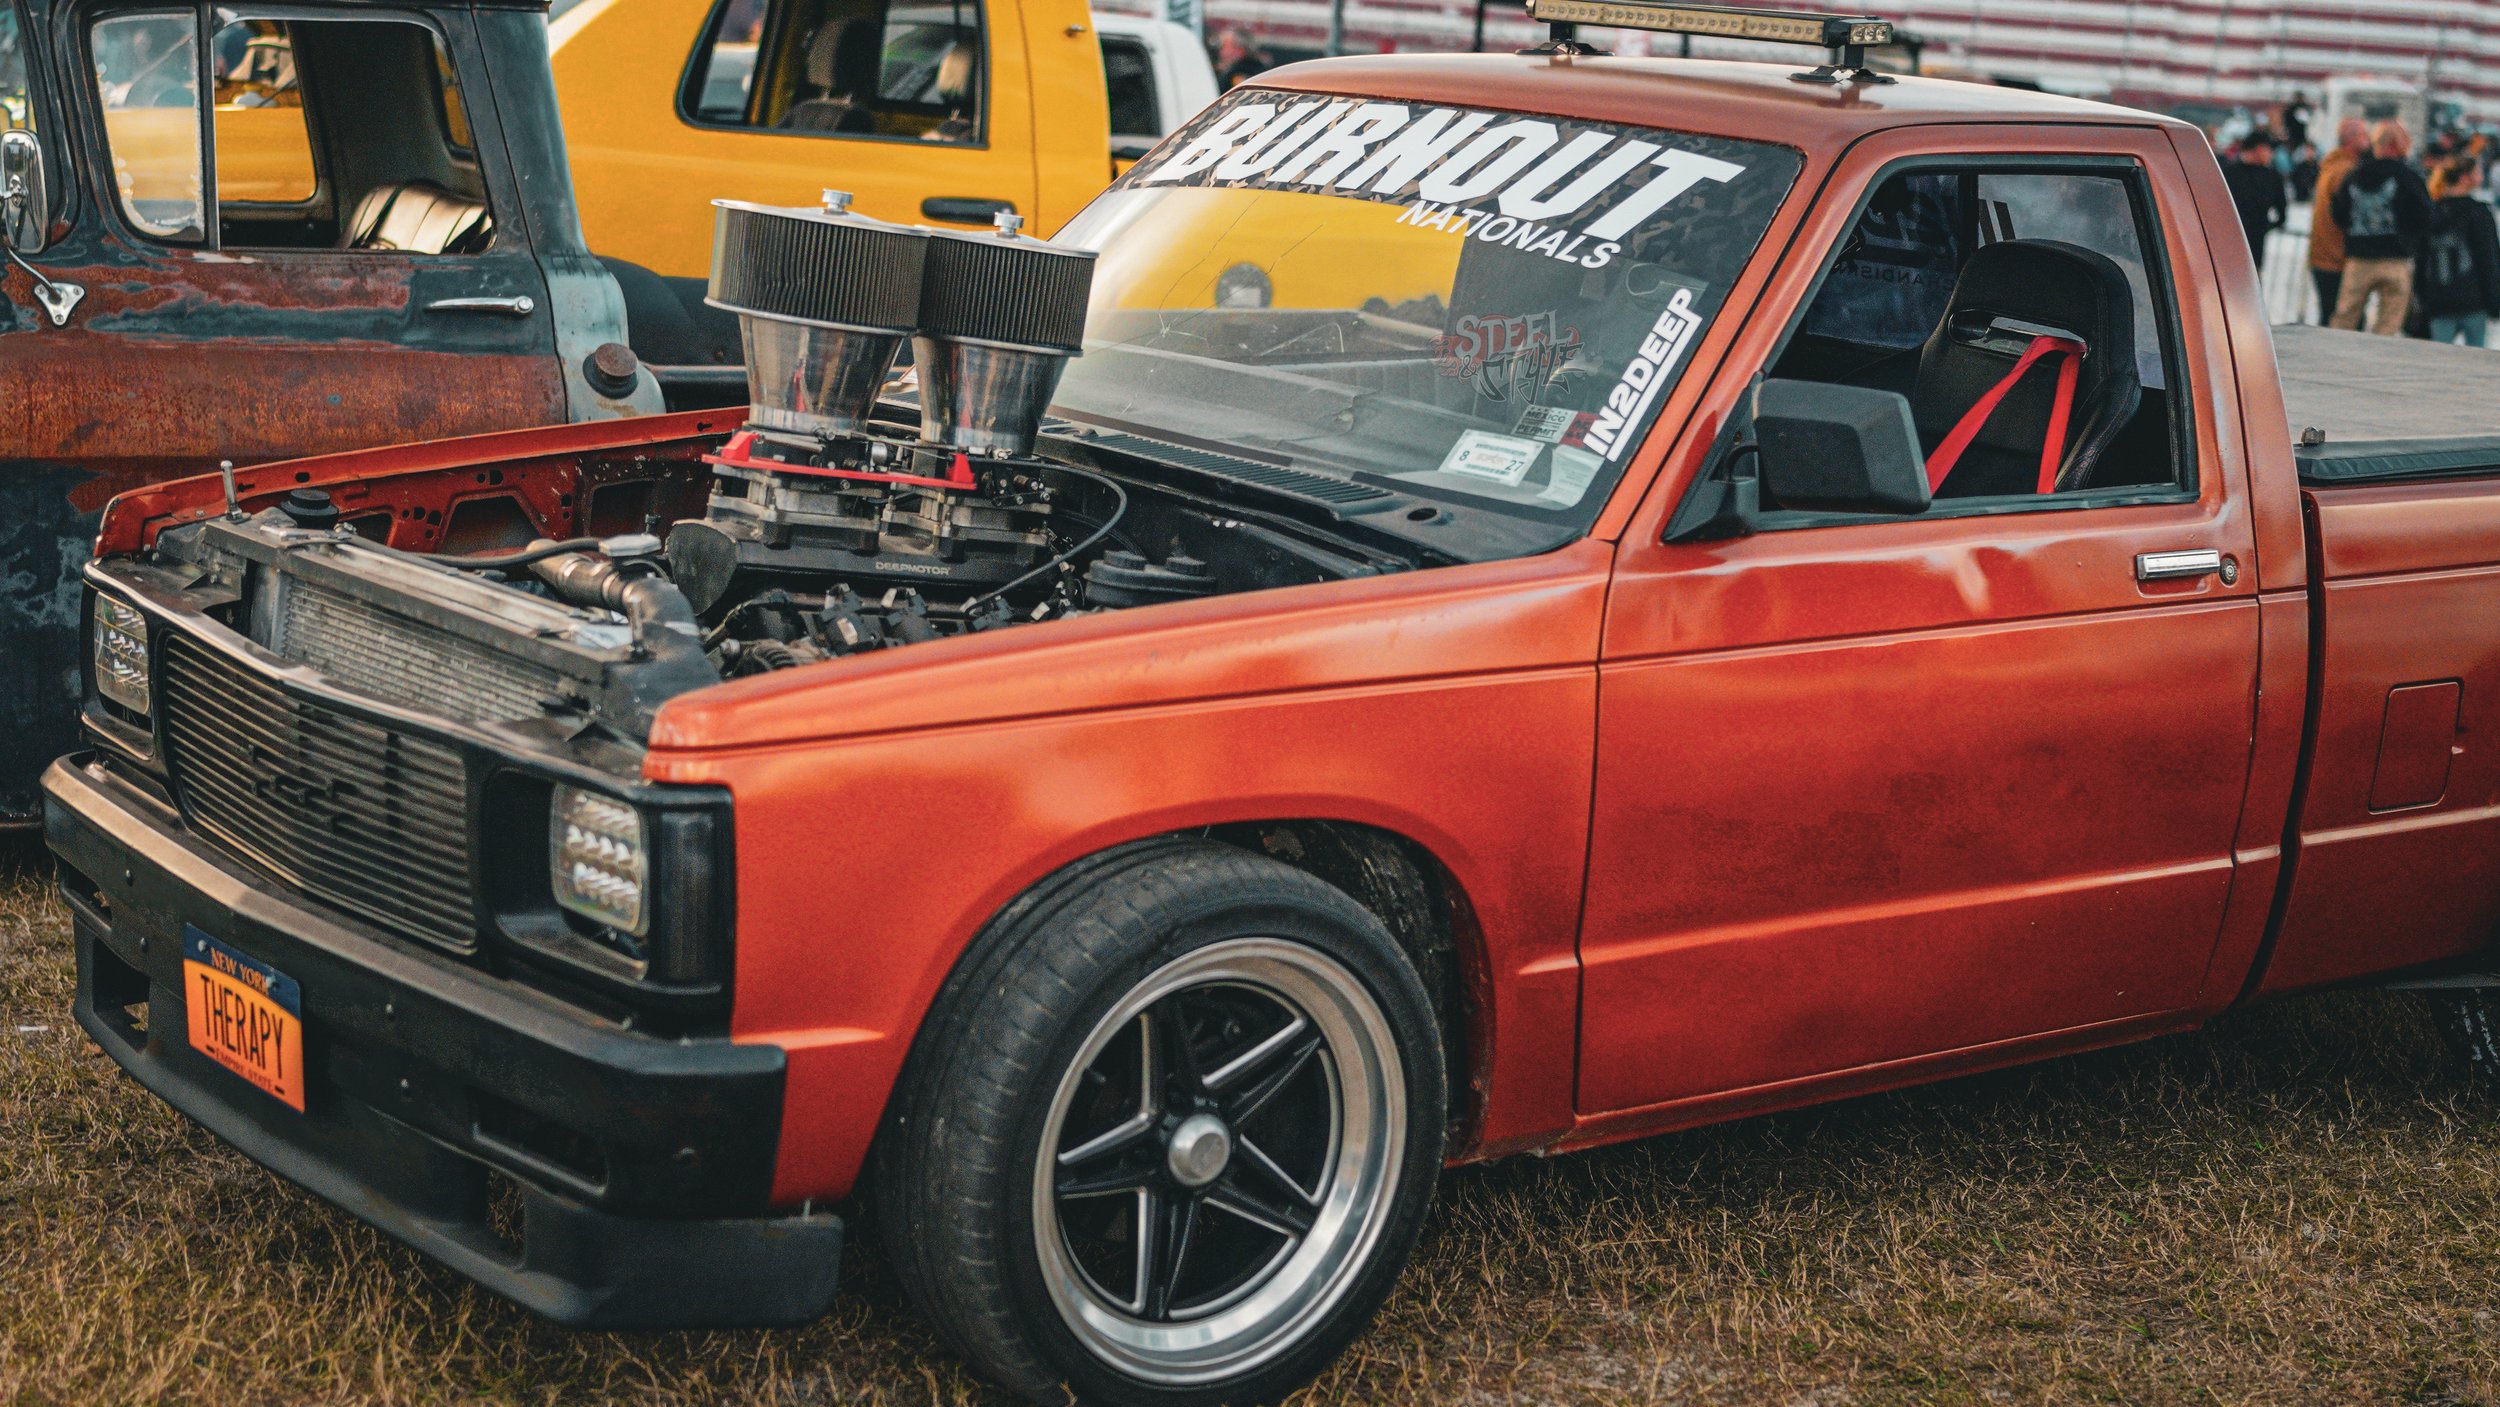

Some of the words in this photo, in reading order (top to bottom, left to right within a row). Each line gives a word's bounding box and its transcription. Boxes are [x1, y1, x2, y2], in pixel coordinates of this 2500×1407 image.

[1146, 101, 1746, 242] BURNOUT
[1397, 200, 1621, 270] NATIONALS
[1455, 310, 1574, 359] STEEL
[1583, 288, 1694, 457] IN2DEEP
[1527, 410, 1566, 423] MEXICO
[1517, 424, 1557, 437] PERMIT
[1459, 450, 1470, 462] 8
[1504, 459, 1525, 472] 27
[875, 562, 950, 575] DEEPMOTOR
[211, 948, 237, 975] NEW
[200, 973, 282, 1079] THERAPY
